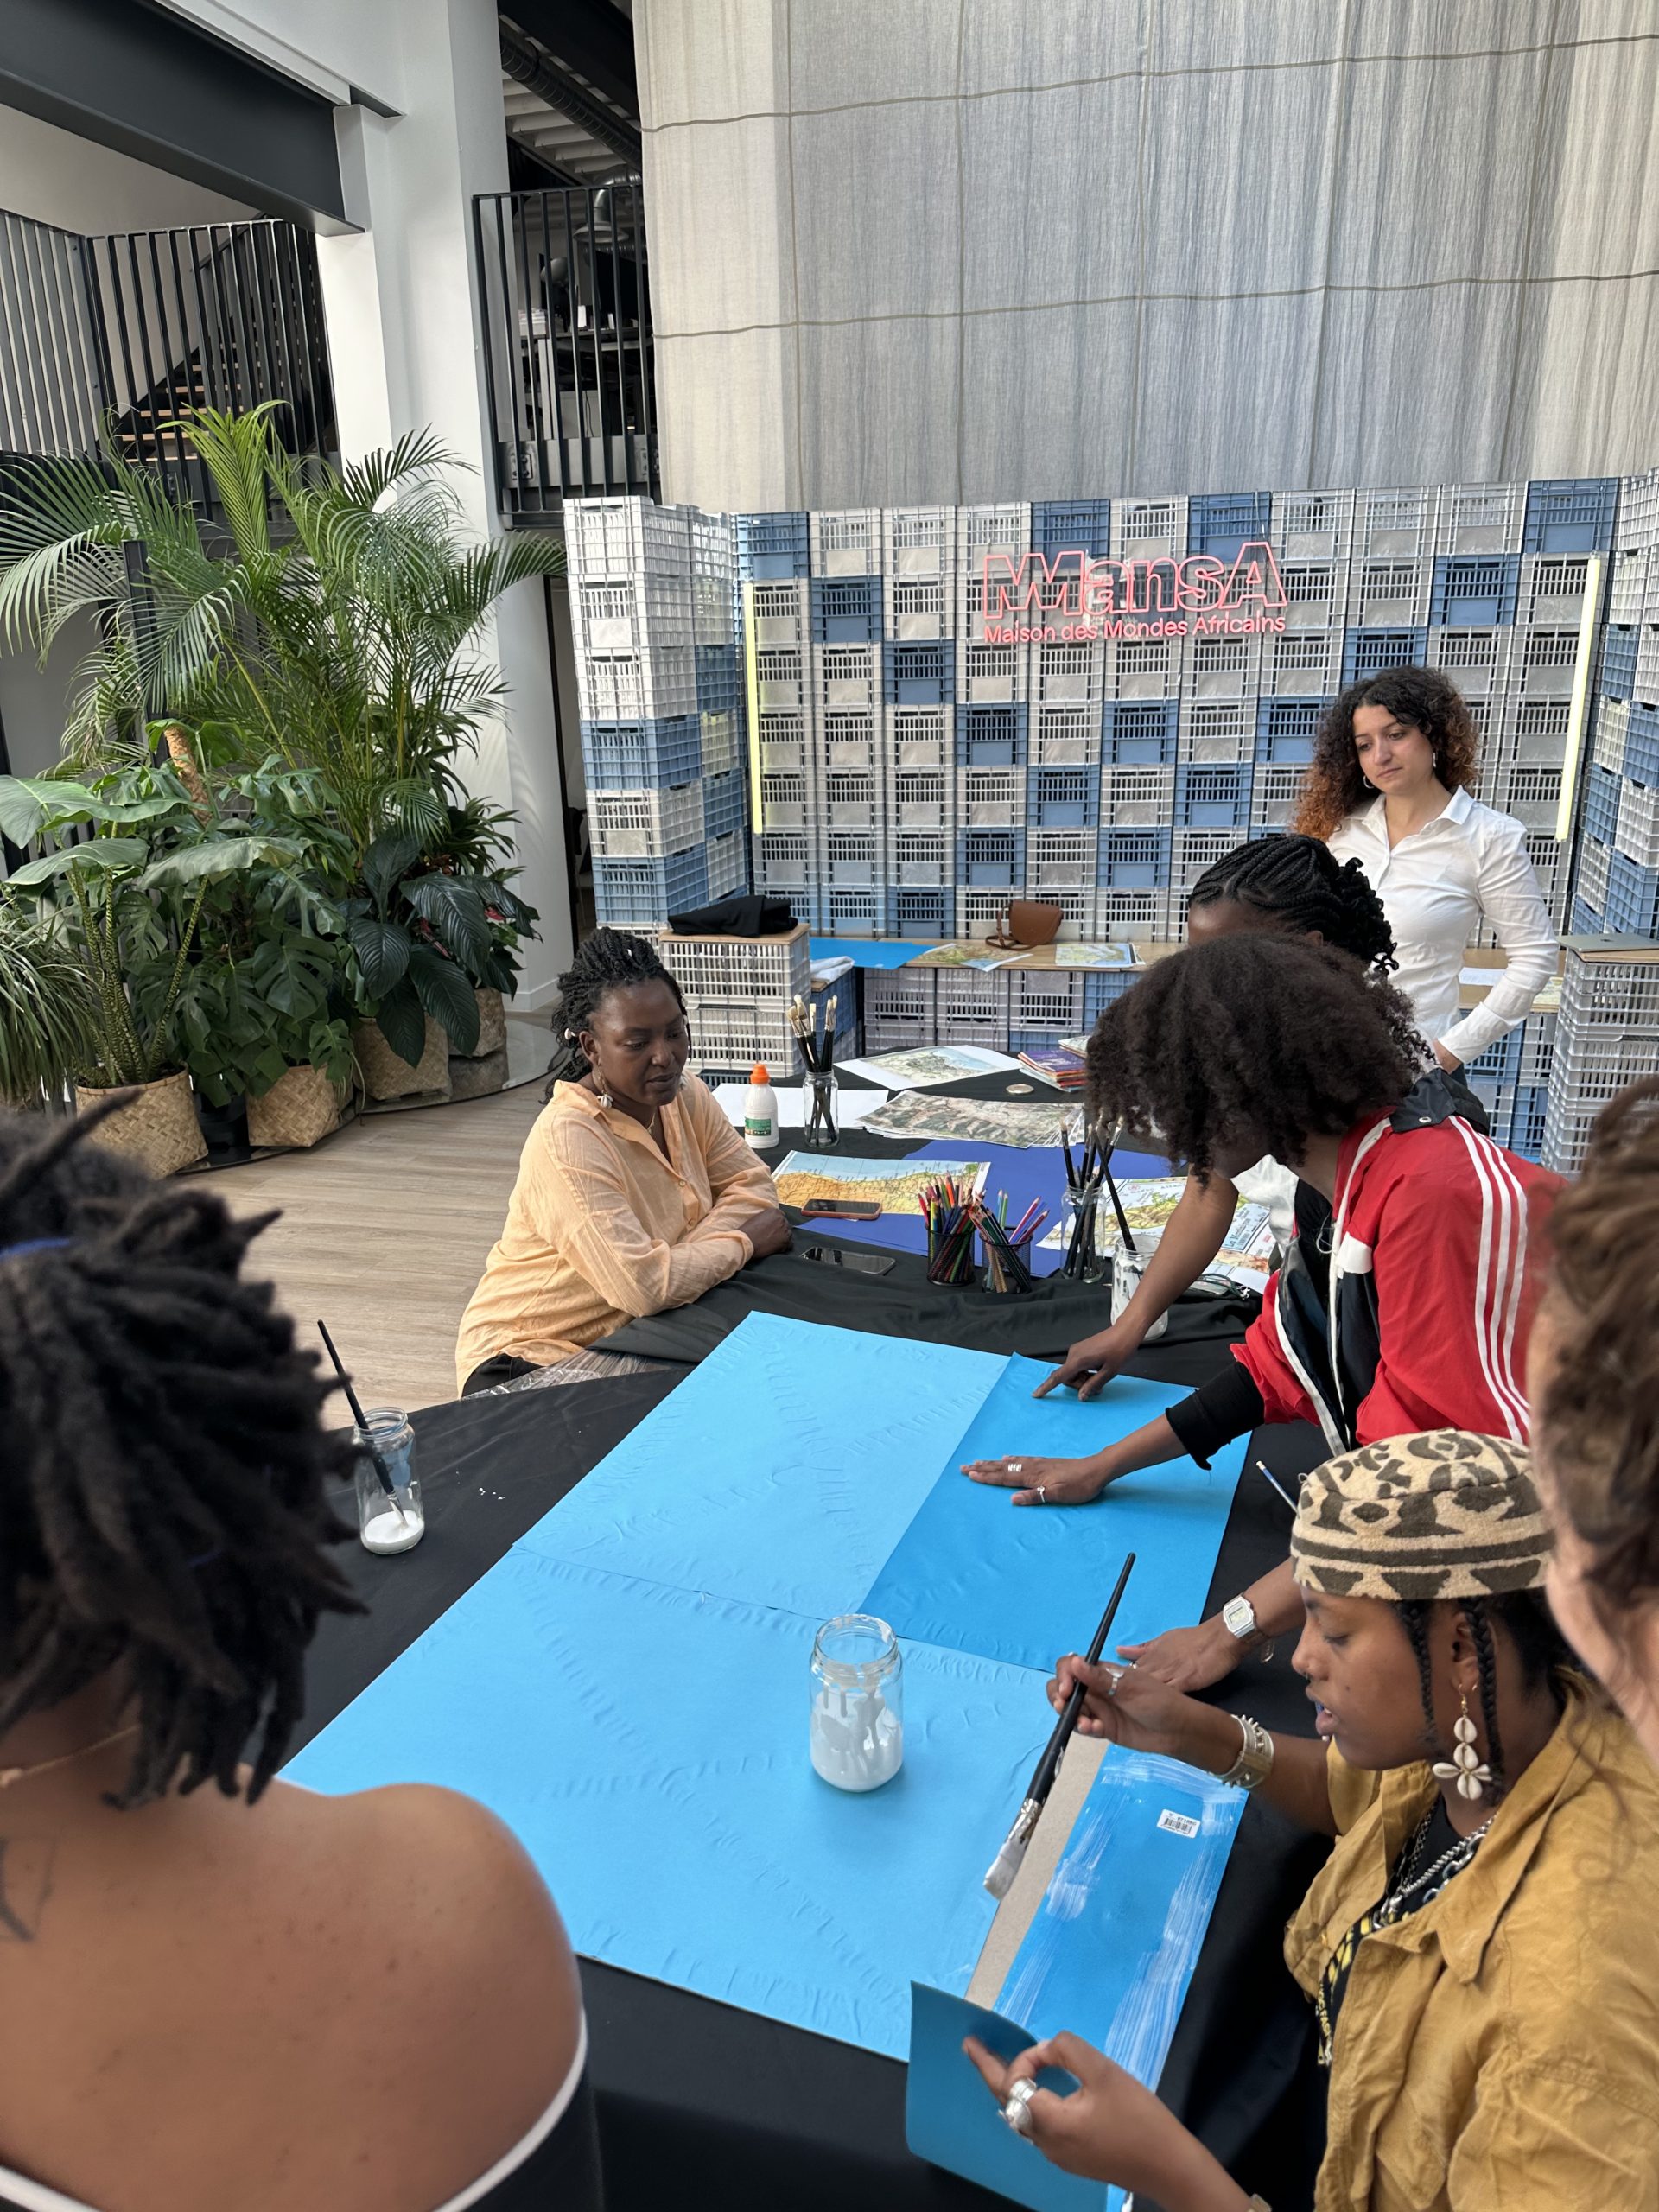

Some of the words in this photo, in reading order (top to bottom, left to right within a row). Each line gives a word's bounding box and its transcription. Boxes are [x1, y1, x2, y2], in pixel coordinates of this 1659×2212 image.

[983, 542, 1287, 619] MansA
[984, 620, 1056, 643] Maison
[1061, 622, 1098, 640] des
[1103, 617, 1188, 639] Mondes
[1192, 610, 1287, 636] Africains
